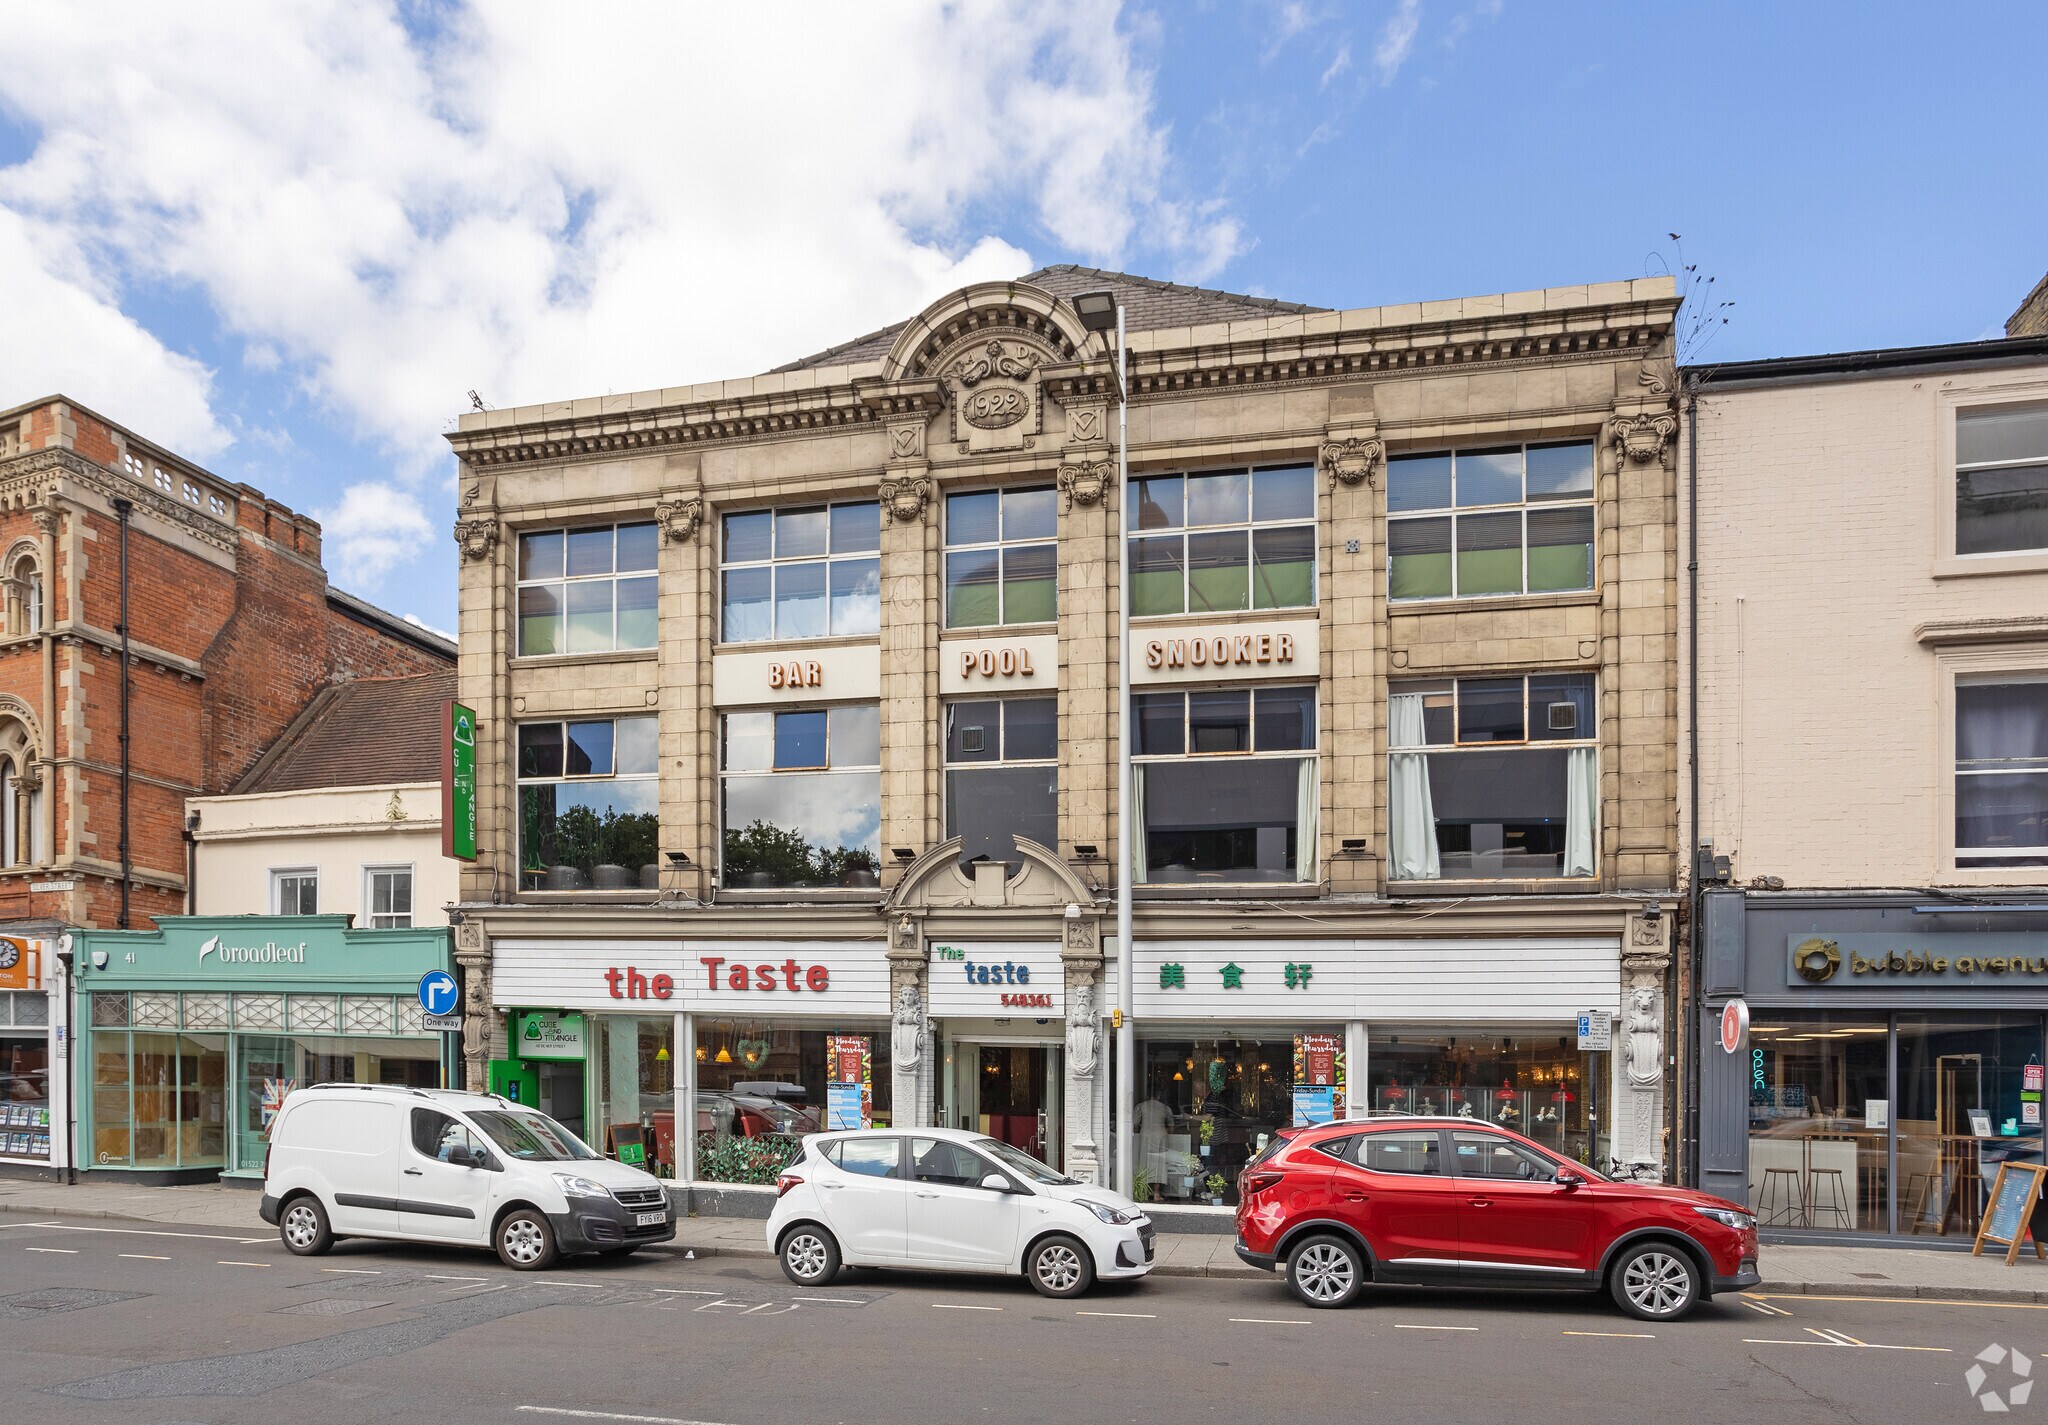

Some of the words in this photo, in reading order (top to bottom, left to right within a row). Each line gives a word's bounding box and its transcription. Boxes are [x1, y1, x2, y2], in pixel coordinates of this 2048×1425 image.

[969, 394, 1022, 420] 1922
[1146, 633, 1294, 669] SNOOKER
[768, 660, 821, 689] BAR
[960, 648, 1034, 679] POOL
[51, 881, 73, 890] STREET
[124, 952, 137, 964] 41
[218, 942, 307, 963] broadleaf
[937, 946, 965, 960] The
[1851, 949, 1950, 975] bubble
[604, 966, 675, 999] the
[700, 957, 829, 992] Taste
[964, 961, 1030, 984] taste
[1159, 961, 1313, 990] 美食轩
[1000, 993, 1054, 1007] 548361
[426, 1018, 442, 1027] One
[443, 1019, 459, 1028] way
[1303, 1043, 1339, 1055] Thursday
[1752, 1048, 1765, 1090] open
